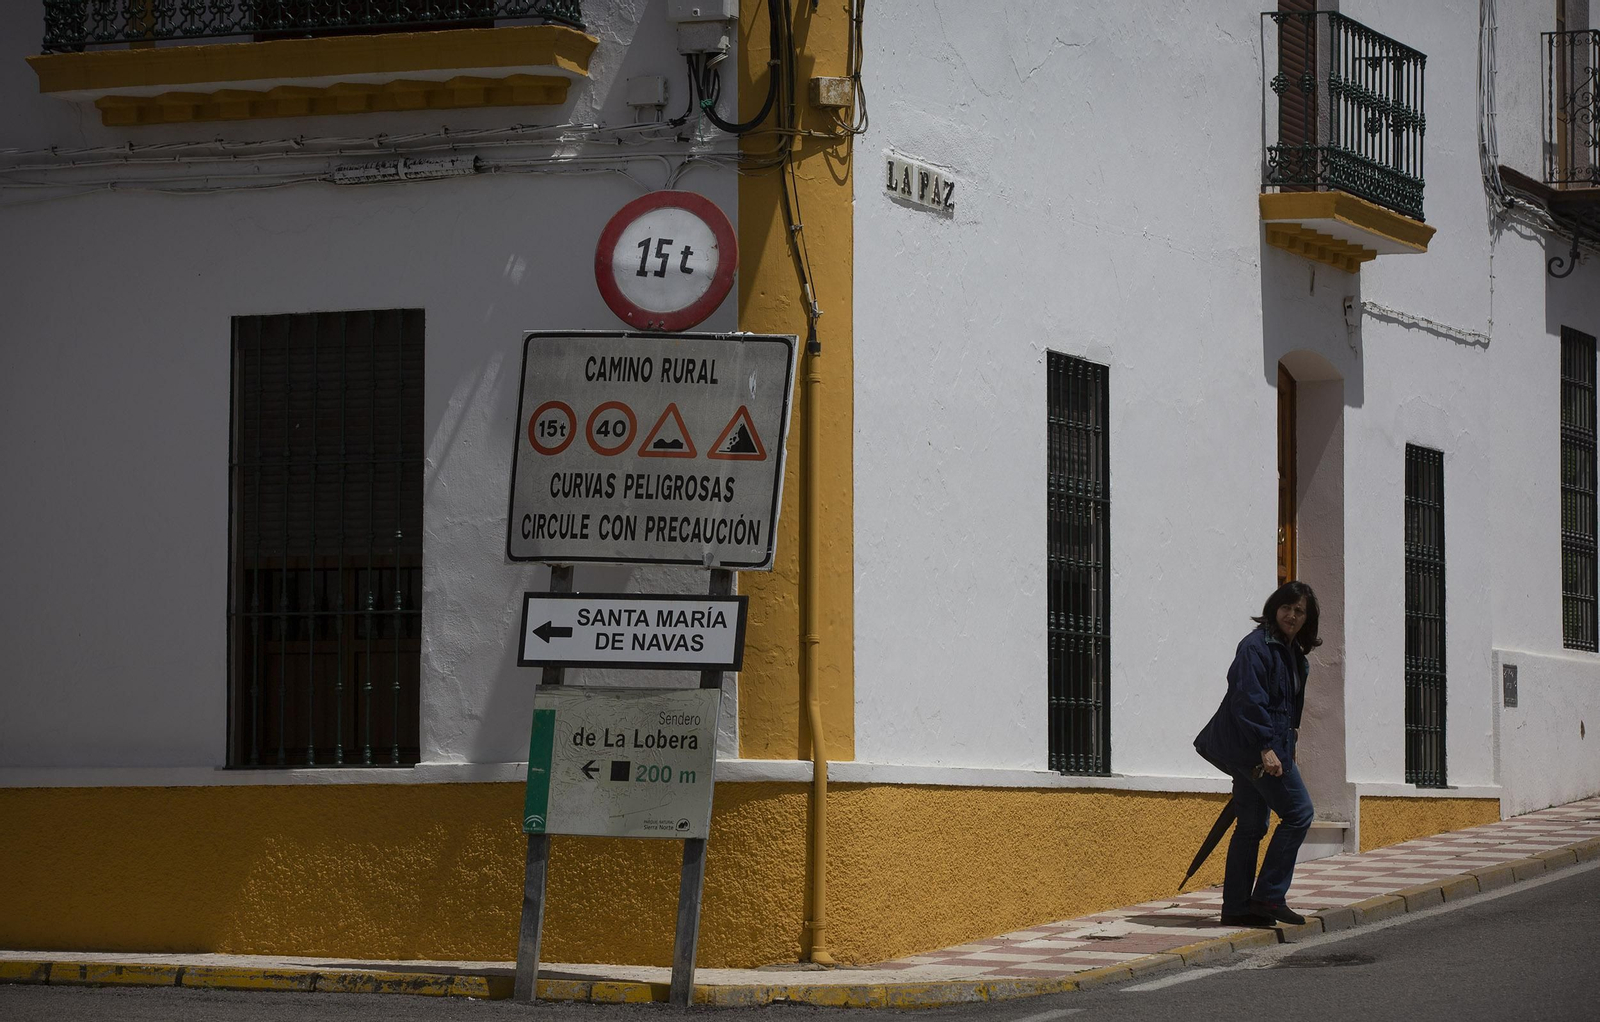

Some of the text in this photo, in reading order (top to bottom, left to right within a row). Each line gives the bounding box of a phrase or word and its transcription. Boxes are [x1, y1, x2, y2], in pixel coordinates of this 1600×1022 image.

[887, 160, 955, 209] LA PAZ
[636, 237, 694, 278] 15 t
[585, 356, 718, 385] CAMINO RURAL
[539, 419, 566, 438] 15t
[596, 419, 627, 438] 40
[550, 472, 736, 503] CURVAS PELIGROSAS
[521, 513, 761, 545] CIRCULE CON PRECAUCIÓN
[576, 606, 728, 628] SANTA MARÍA
[595, 632, 704, 652] DE NAVAS
[658, 711, 700, 726] Sendero
[572, 727, 698, 750] de La Lobera
[635, 764, 696, 784] 200 m
